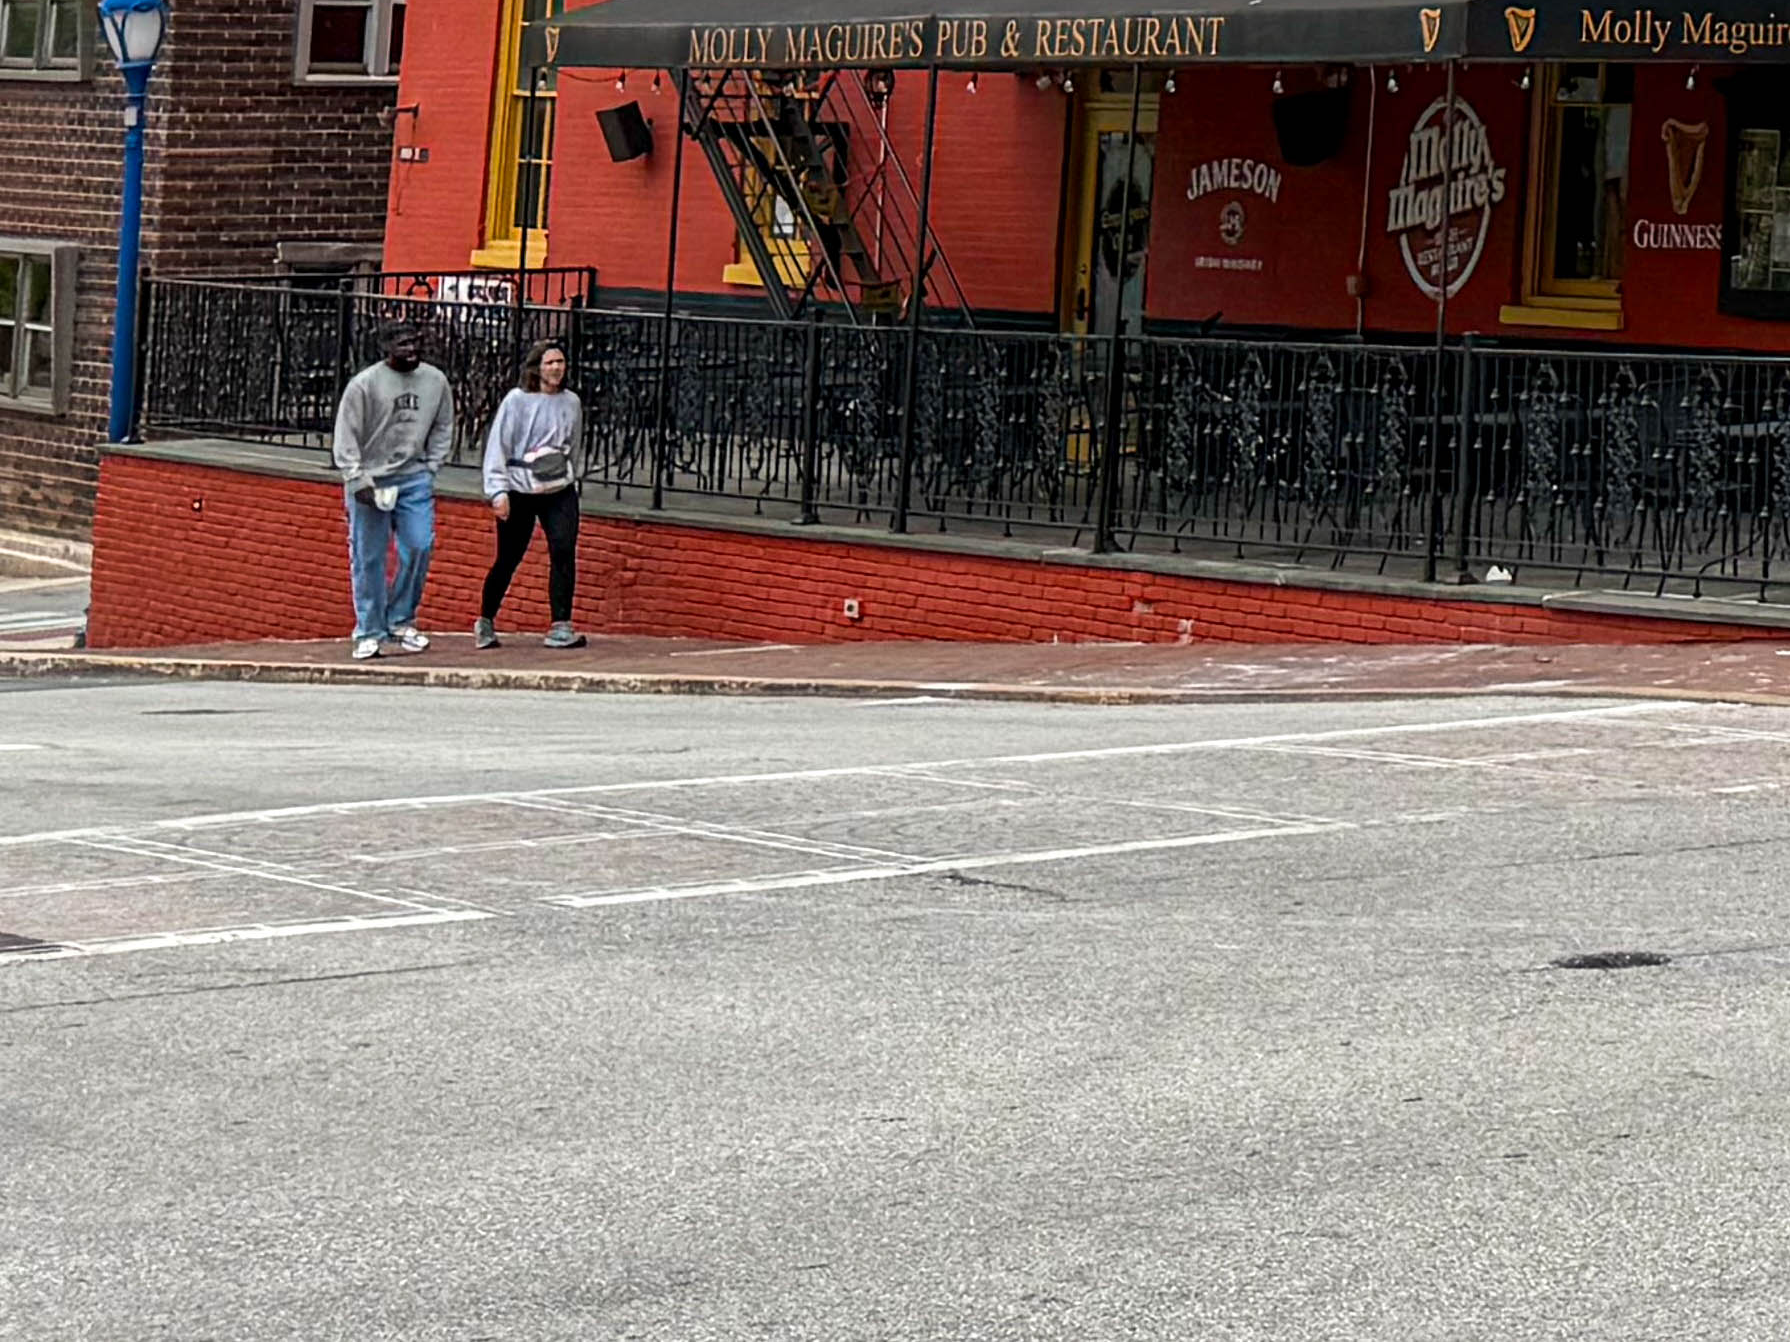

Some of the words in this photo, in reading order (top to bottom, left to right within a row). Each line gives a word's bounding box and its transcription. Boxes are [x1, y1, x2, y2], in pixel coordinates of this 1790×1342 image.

[688, 26, 773, 64] MOLLY
[784, 21, 923, 63] MAGUIRE'S
[936, 19, 987, 58] PUB
[1001, 19, 1021, 56] &
[1035, 16, 1225, 58] RESTAURANT
[1579, 9, 1672, 53] Molly
[1186, 156, 1283, 204] JAMESON
